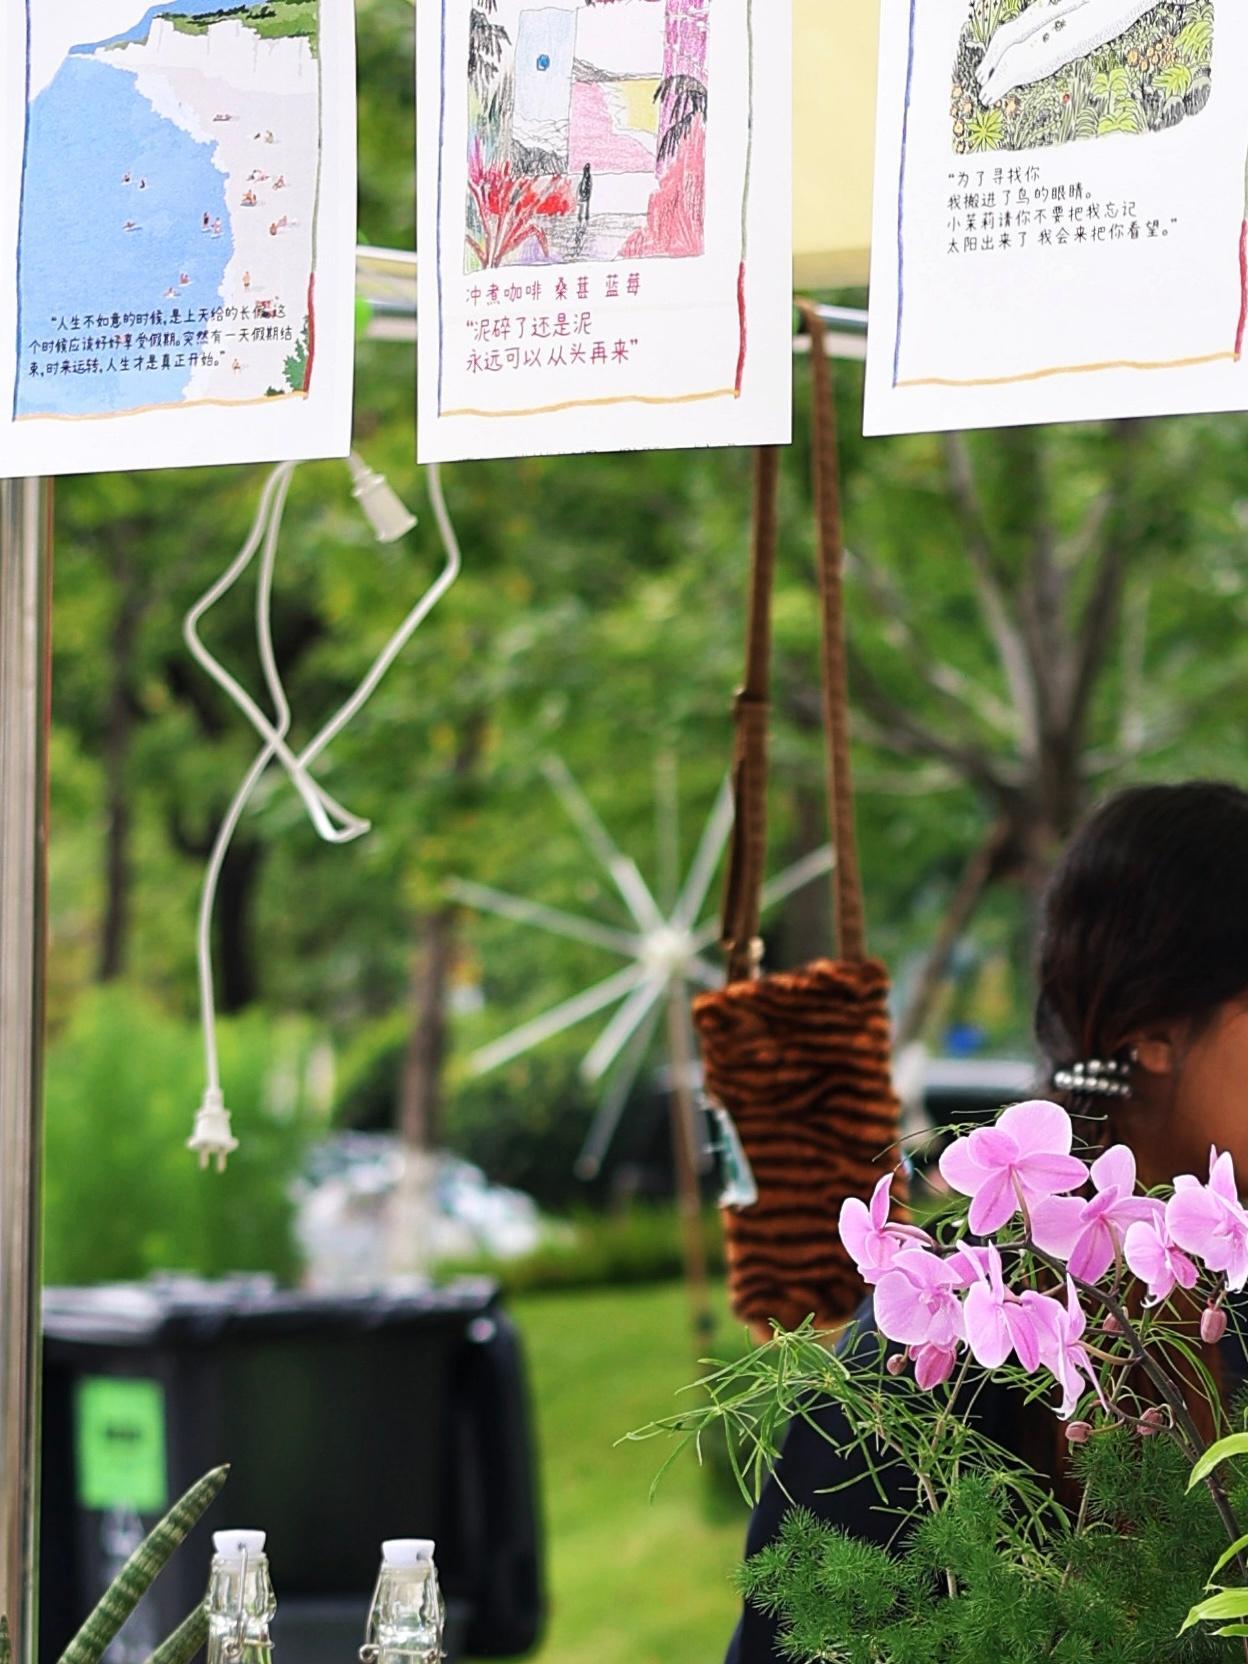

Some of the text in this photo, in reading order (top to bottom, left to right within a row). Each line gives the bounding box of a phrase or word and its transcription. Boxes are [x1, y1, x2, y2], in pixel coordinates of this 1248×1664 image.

[947, 201, 1136, 232] 小茉莉请你不要把我忘记
[466, 280, 542, 306] 冲煮咖啡
